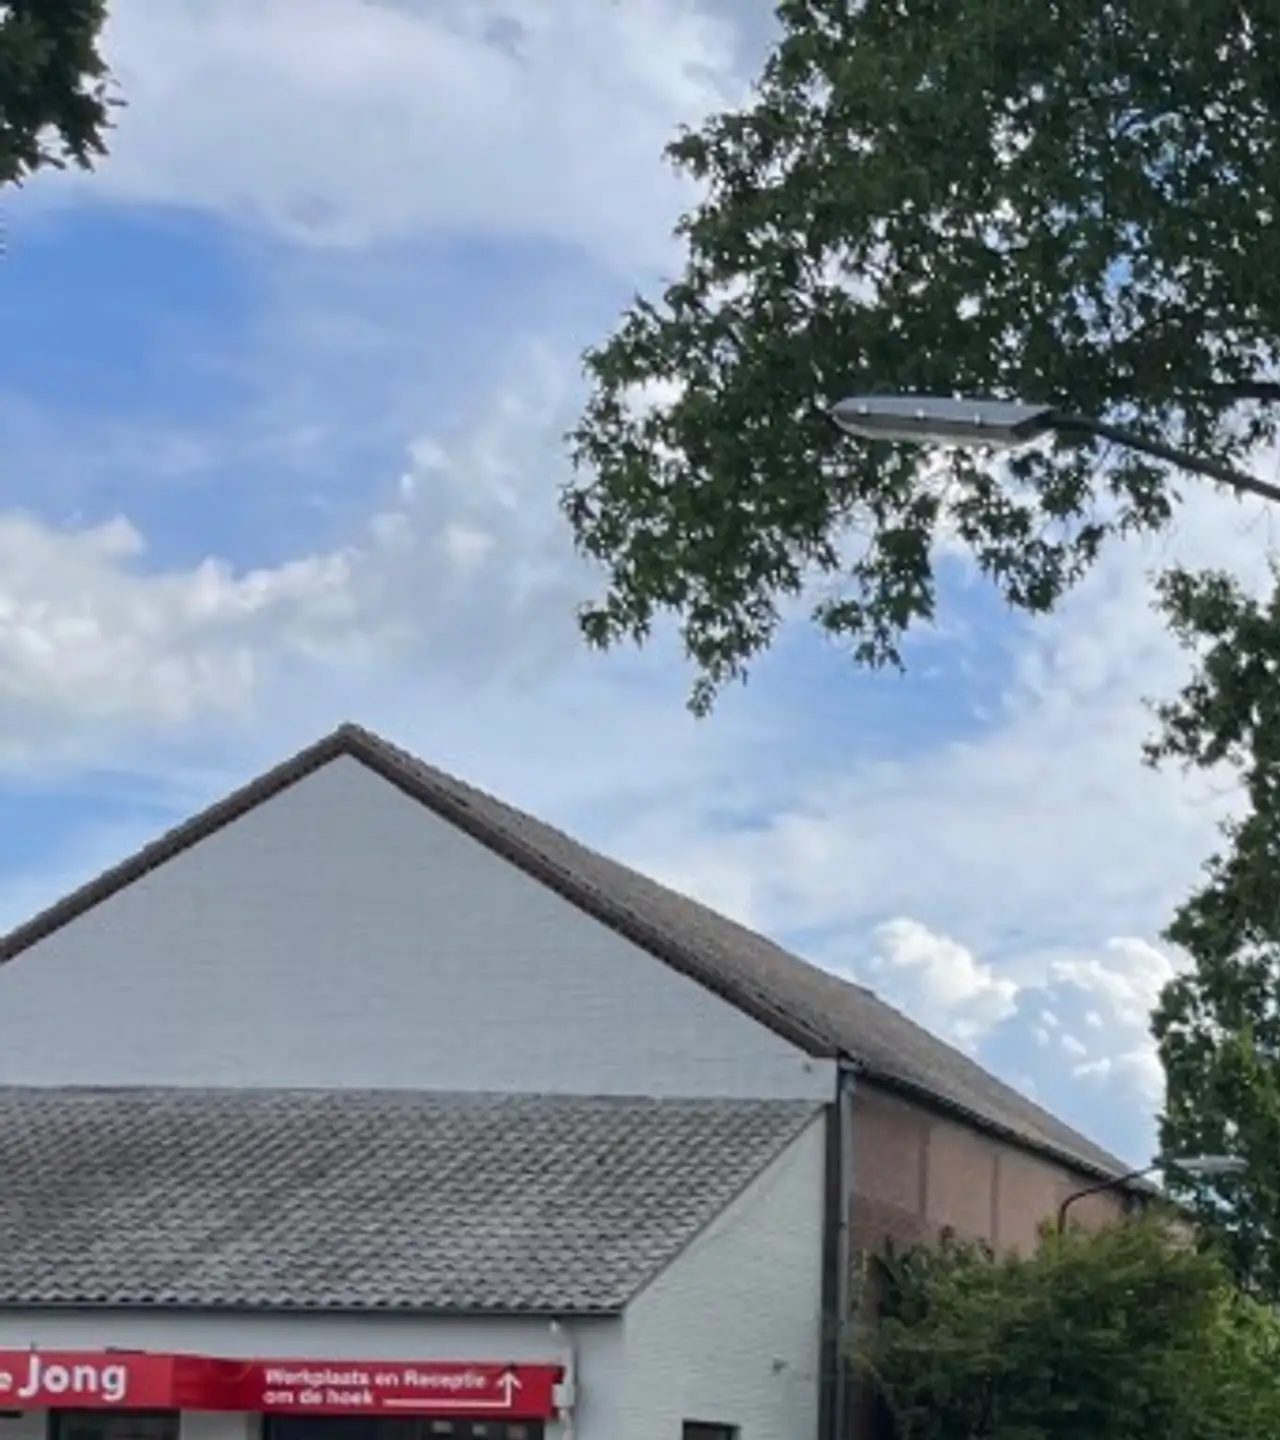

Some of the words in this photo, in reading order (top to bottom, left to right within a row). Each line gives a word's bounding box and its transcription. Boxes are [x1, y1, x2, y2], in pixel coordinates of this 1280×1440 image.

[17, 1354, 127, 1402] Jong
[264, 1368, 370, 1387] Werkplaats
[375, 1373, 399, 1387] en
[404, 1369, 486, 1391] Receptie
[263, 1389, 294, 1404] om
[299, 1387, 323, 1404] de
[326, 1387, 374, 1405] hoek
